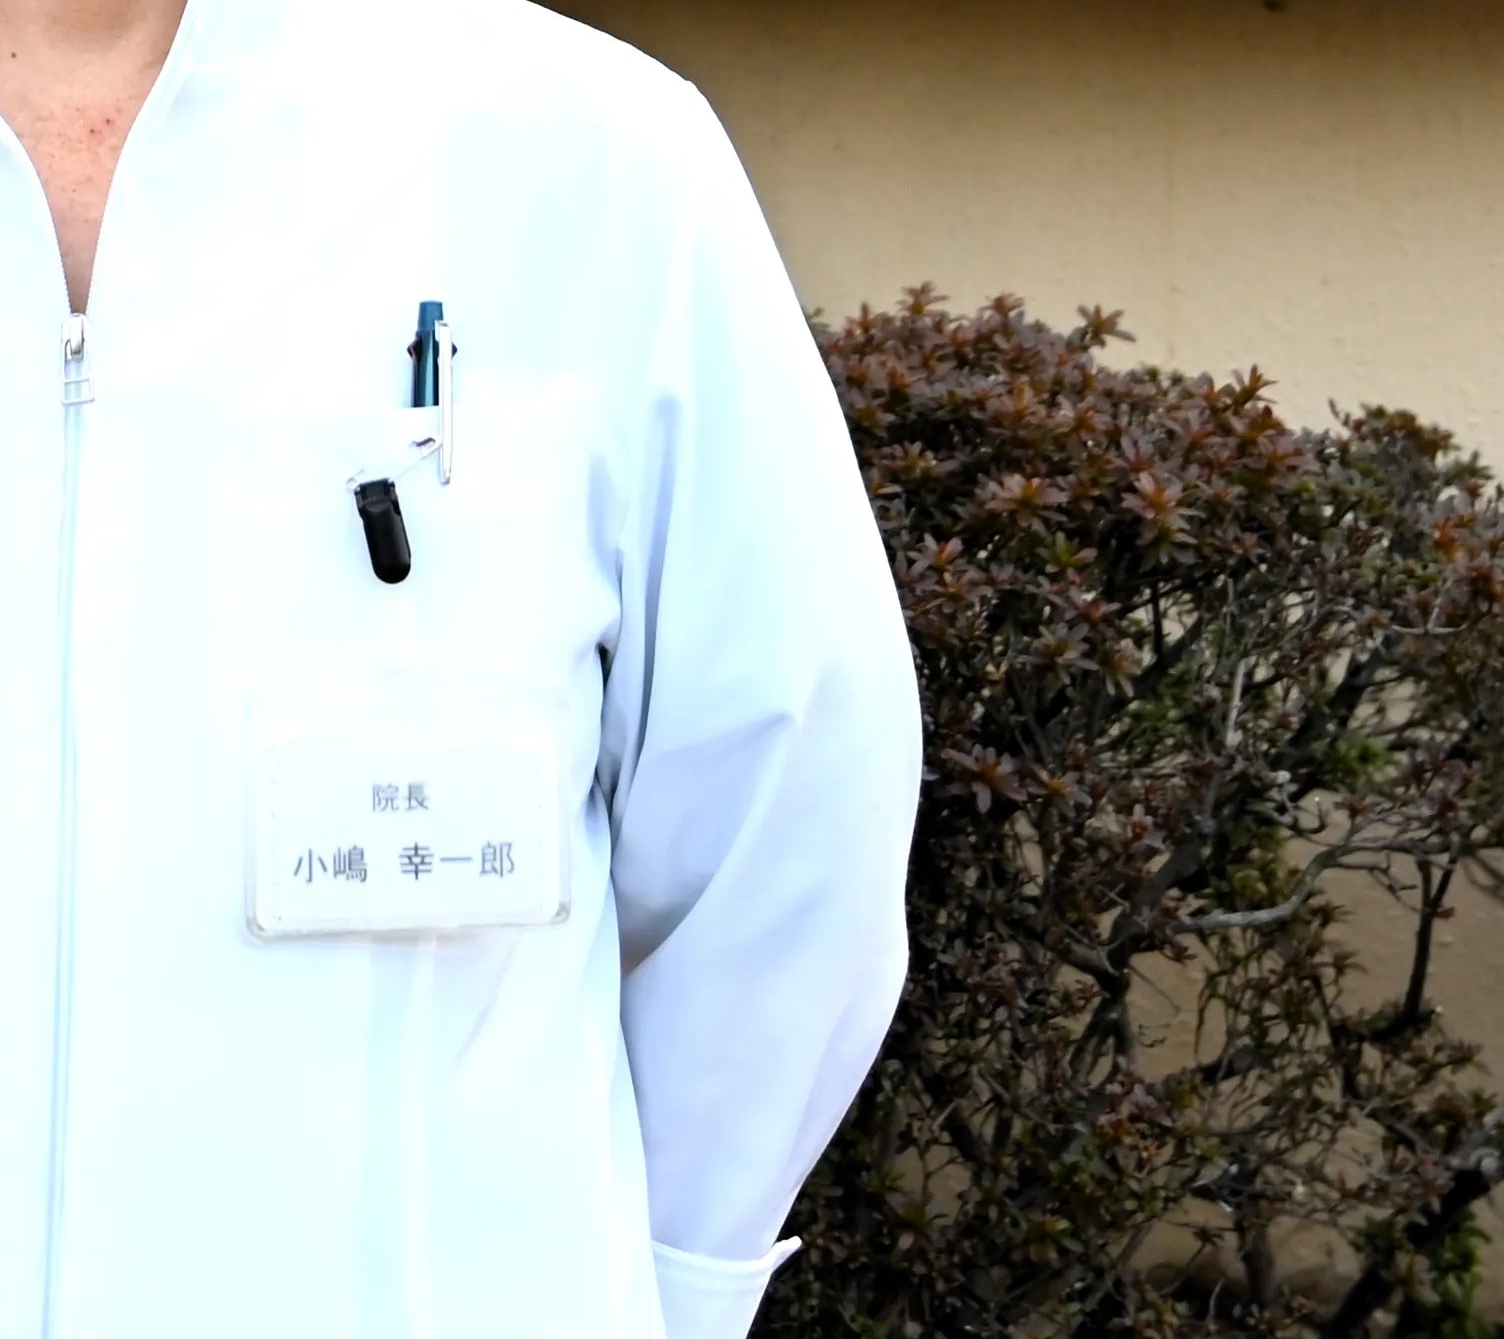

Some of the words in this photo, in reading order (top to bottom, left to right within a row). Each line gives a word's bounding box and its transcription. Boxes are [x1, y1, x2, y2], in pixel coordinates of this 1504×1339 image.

[372, 782, 430, 812] 院長
[293, 844, 369, 884] 小嶋
[398, 841, 516, 881] 幸一郎
